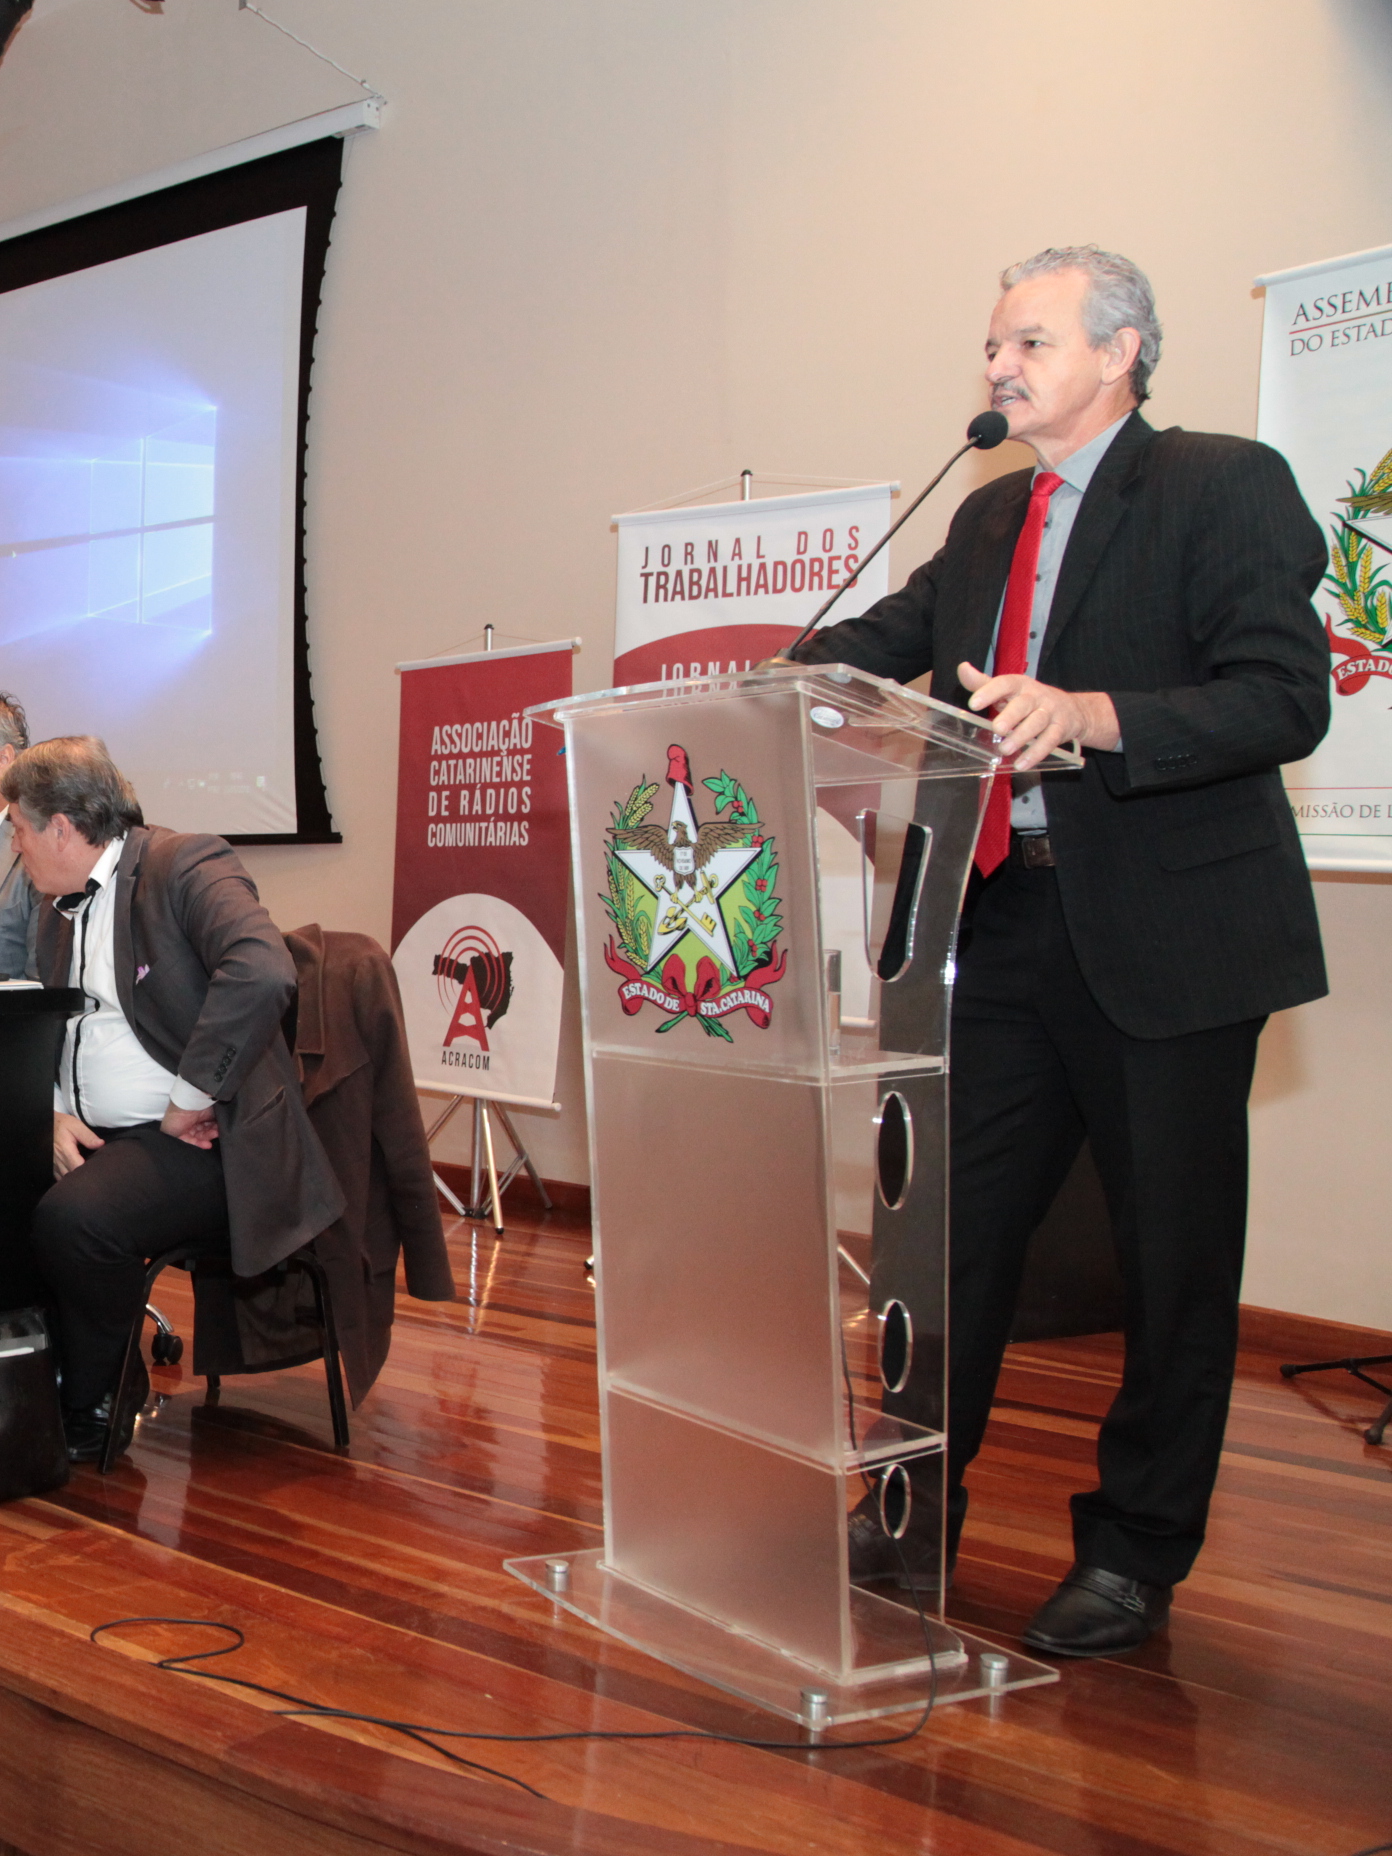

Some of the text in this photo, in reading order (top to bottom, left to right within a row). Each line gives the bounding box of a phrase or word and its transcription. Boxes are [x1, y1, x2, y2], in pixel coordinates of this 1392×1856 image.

[1290, 333, 1324, 357] DO
[641, 525, 860, 569] JORNAL DOS
[639, 553, 860, 604] TRABALHADORES
[431, 712, 533, 756] ASSOCIAÇÃO
[429, 754, 533, 786] CATARINENSE
[428, 783, 532, 817] DE RÁDIOS
[1291, 802, 1354, 818] MISSÃO
[1358, 804, 1381, 818] DE
[427, 816, 530, 847] COMUNITÁRIAS
[622, 982, 665, 1004] ESTADO
[663, 997, 680, 1012] DE
[441, 1050, 490, 1071] ACRACOM
